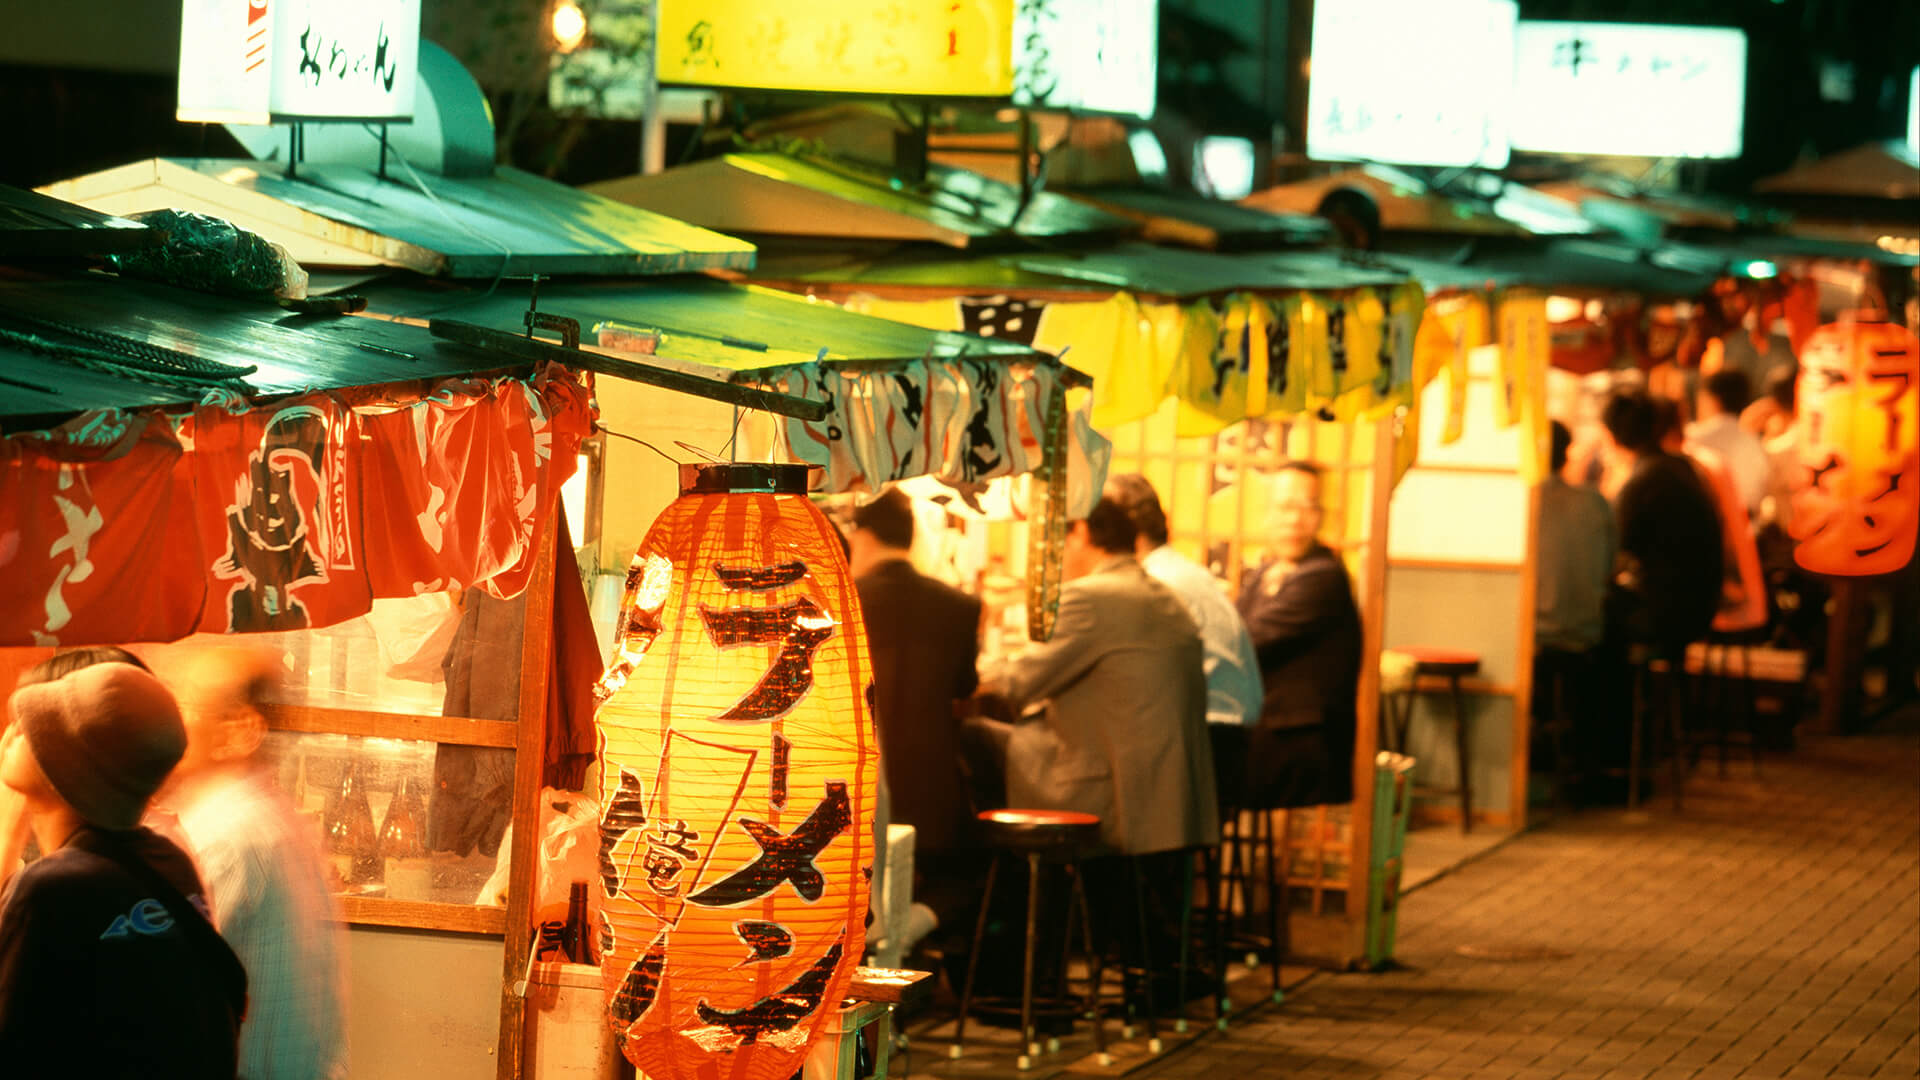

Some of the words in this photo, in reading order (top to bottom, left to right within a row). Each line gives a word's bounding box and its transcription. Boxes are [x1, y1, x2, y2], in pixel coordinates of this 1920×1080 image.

[1854, 346, 1911, 560] ラーメン
[686, 559, 854, 1036] ラーメン
